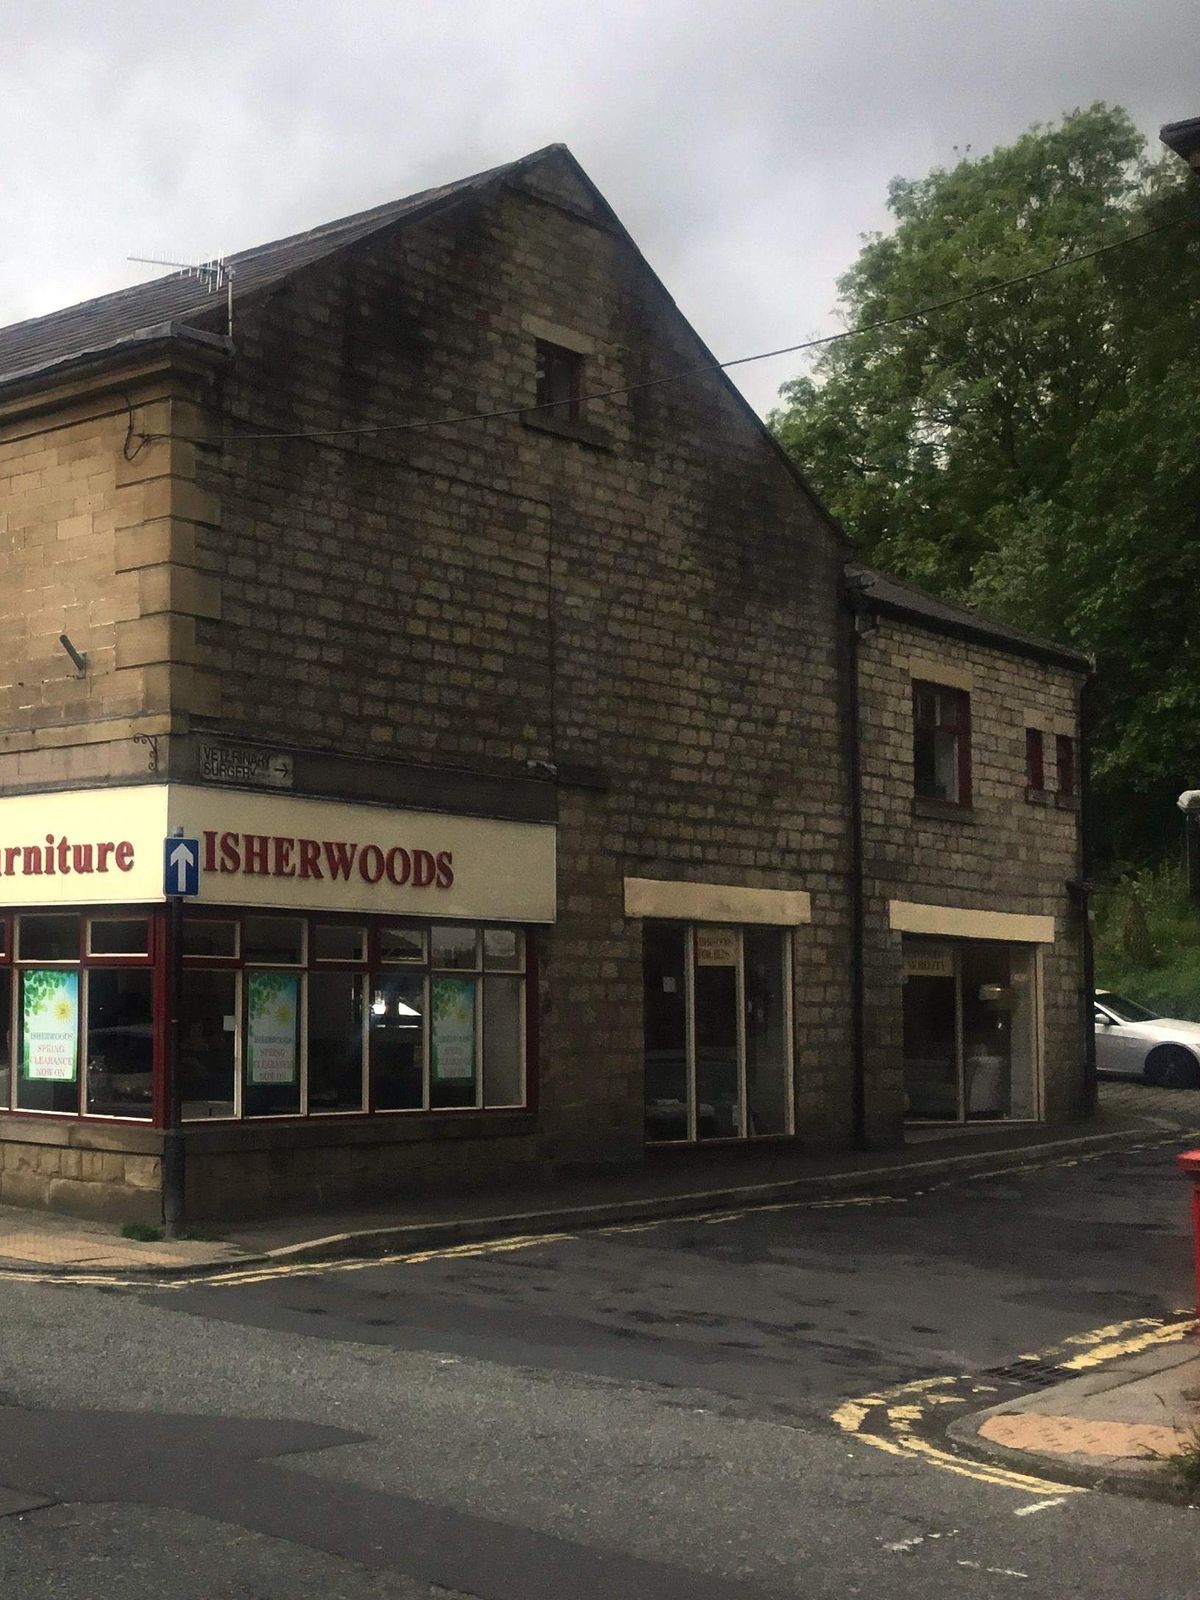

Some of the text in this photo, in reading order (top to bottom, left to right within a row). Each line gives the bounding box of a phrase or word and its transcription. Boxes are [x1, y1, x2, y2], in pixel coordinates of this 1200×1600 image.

[203, 744, 271, 769] VETERINARY
[203, 761, 256, 779] SURGERY
[203, 831, 455, 889] ISHERWOODS
[37, 1044, 65, 1053] SPRING
[29, 1056, 73, 1066] CLEARANCE
[36, 1067, 65, 1078] NOW ON
